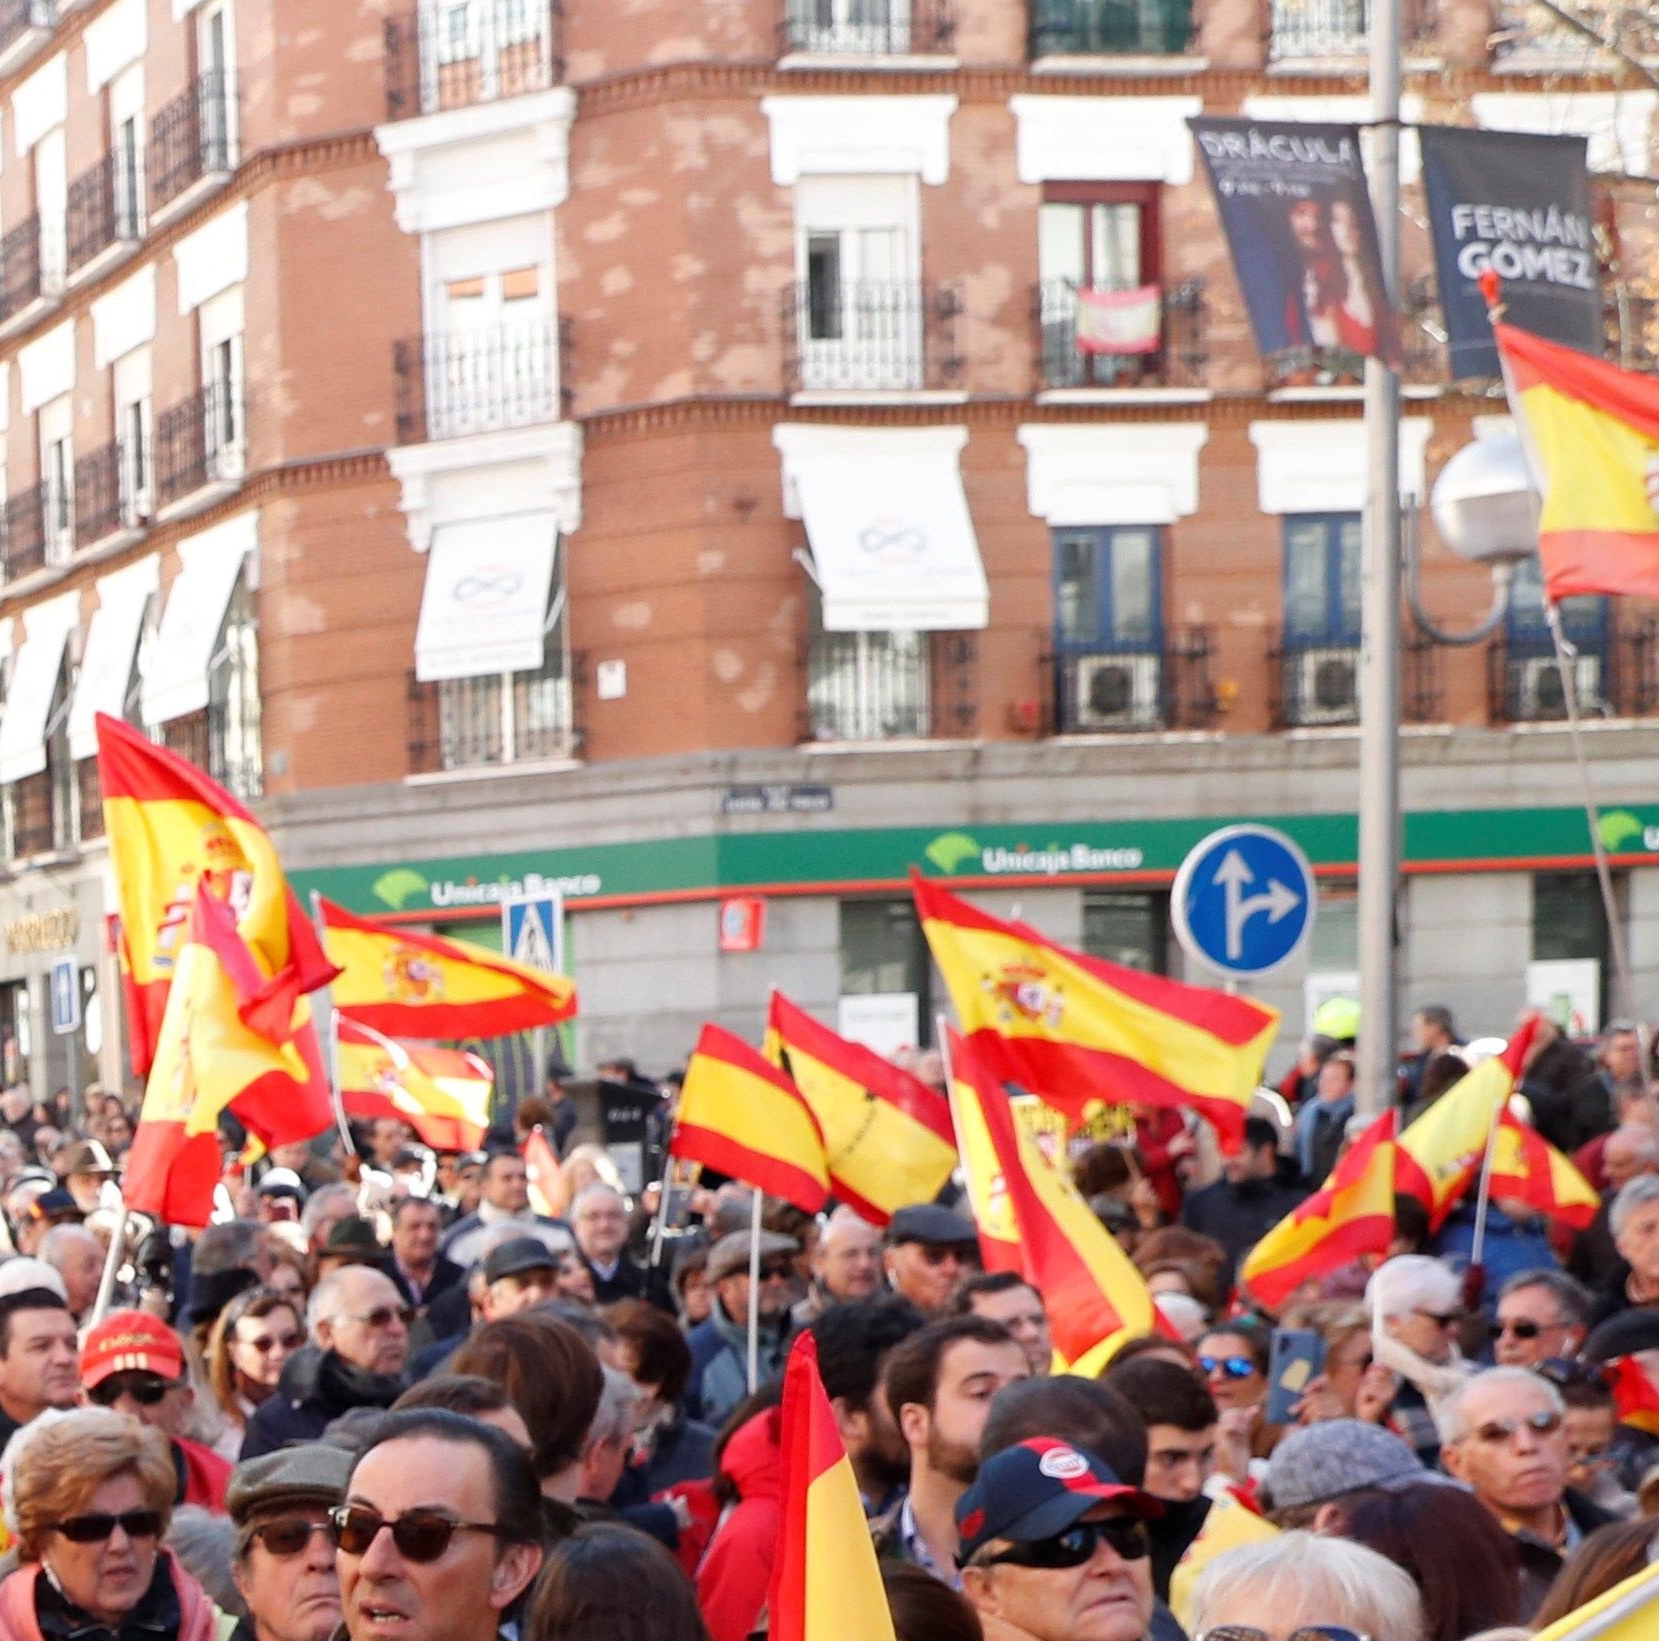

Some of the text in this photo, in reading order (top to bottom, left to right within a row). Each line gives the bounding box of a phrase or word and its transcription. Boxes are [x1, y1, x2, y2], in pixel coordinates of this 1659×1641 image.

[1451, 203, 1591, 249] FERNÁN
[1457, 239, 1597, 290] GÓMEZ
[983, 842, 1143, 876] Unicaja Banco
[430, 873, 602, 907] Unicaja Banco
